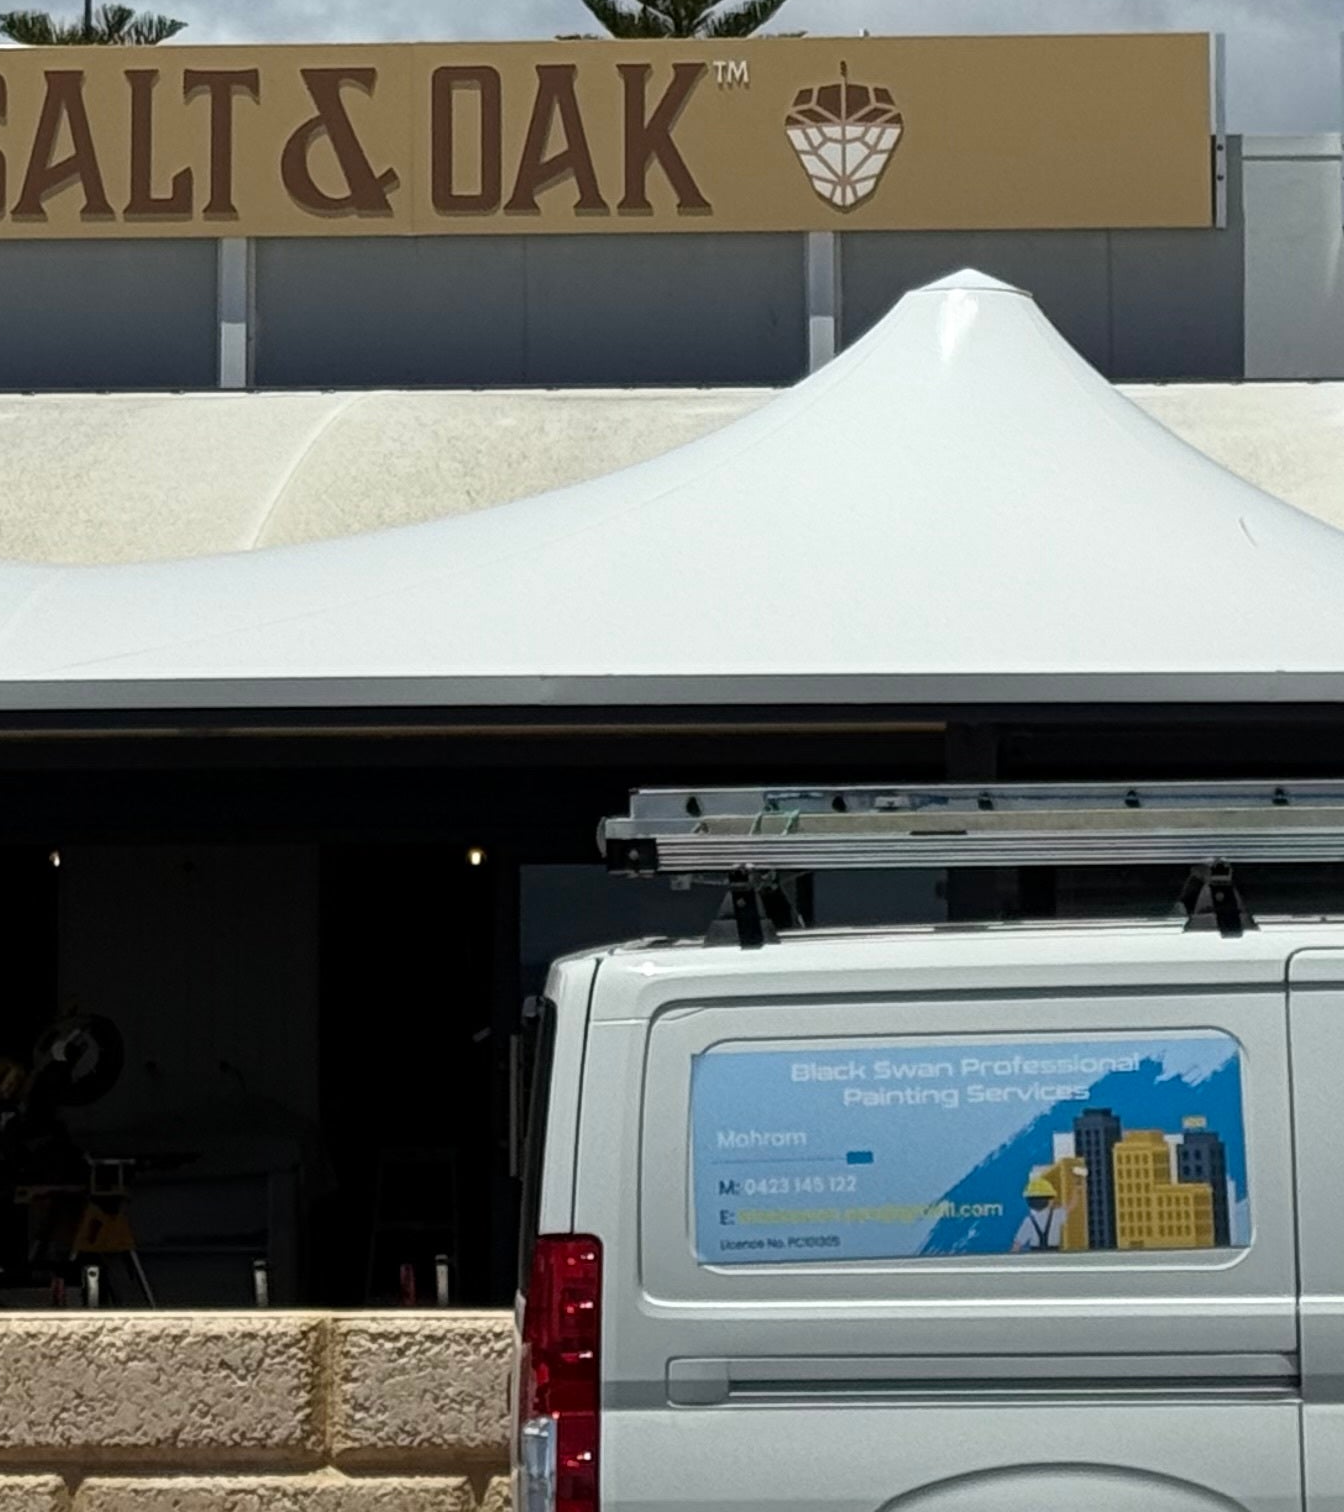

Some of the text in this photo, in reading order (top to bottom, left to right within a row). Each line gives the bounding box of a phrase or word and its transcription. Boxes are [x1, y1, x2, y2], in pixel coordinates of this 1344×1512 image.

[281, 67, 398, 216] &
[430, 63, 712, 216] OAK
[791, 1052, 1141, 1082] Black Swan Professional
[842, 1082, 1091, 1109] Painting Services
